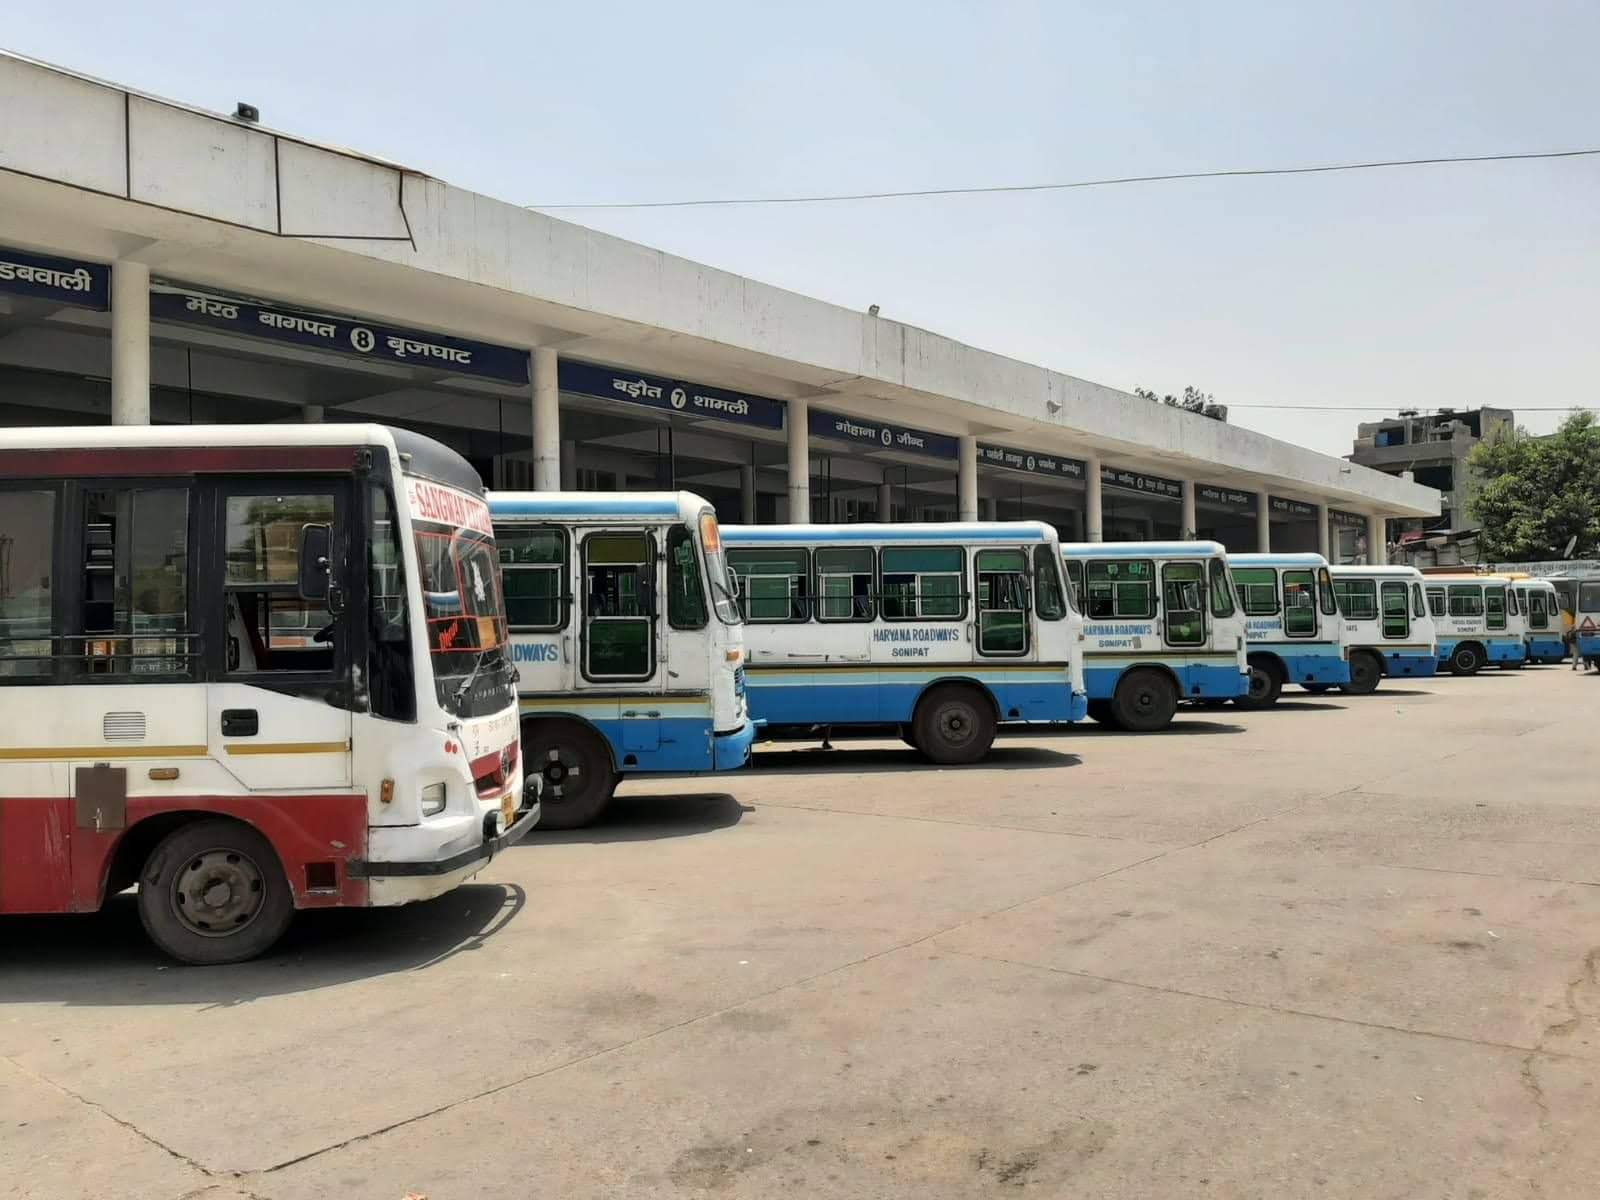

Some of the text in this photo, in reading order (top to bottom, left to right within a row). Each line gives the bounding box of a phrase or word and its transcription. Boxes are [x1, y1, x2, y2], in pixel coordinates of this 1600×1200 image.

[0, 261, 92, 292] डबवाली
[258, 311, 337, 338] बागपत
[386, 335, 472, 364] बृजघाट
[693, 395, 749, 415] शामली
[873, 627, 959, 641] HARYANA ROADWAYS
[1083, 624, 1152, 635] HARYANA ROADWAYS
[1098, 640, 1133, 648] SONIPAT
[891, 647, 930, 657] SONIPAT
